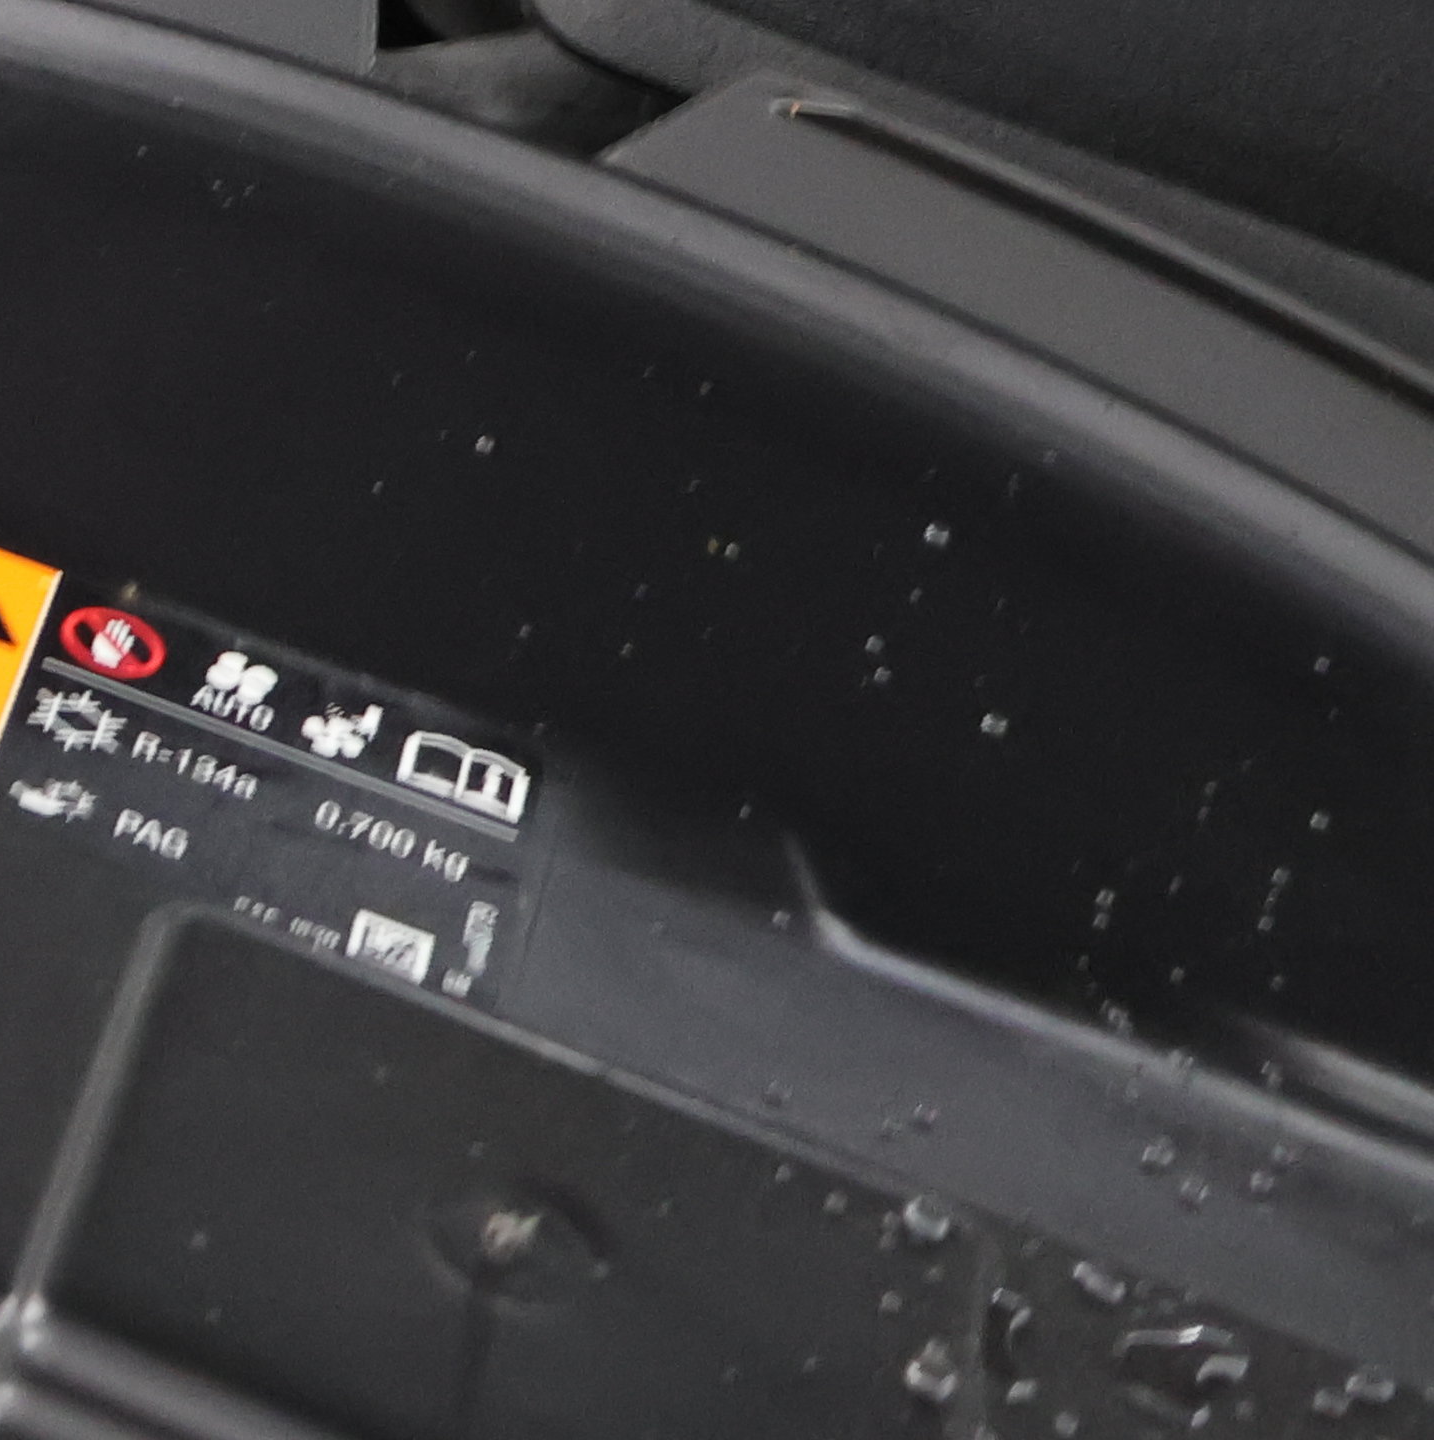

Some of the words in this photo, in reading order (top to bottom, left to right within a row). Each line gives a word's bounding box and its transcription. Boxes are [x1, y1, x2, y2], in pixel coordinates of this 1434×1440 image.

[189, 683, 276, 733] AUTO
[112, 807, 190, 861] PAG
[420, 838, 471, 883] kg
